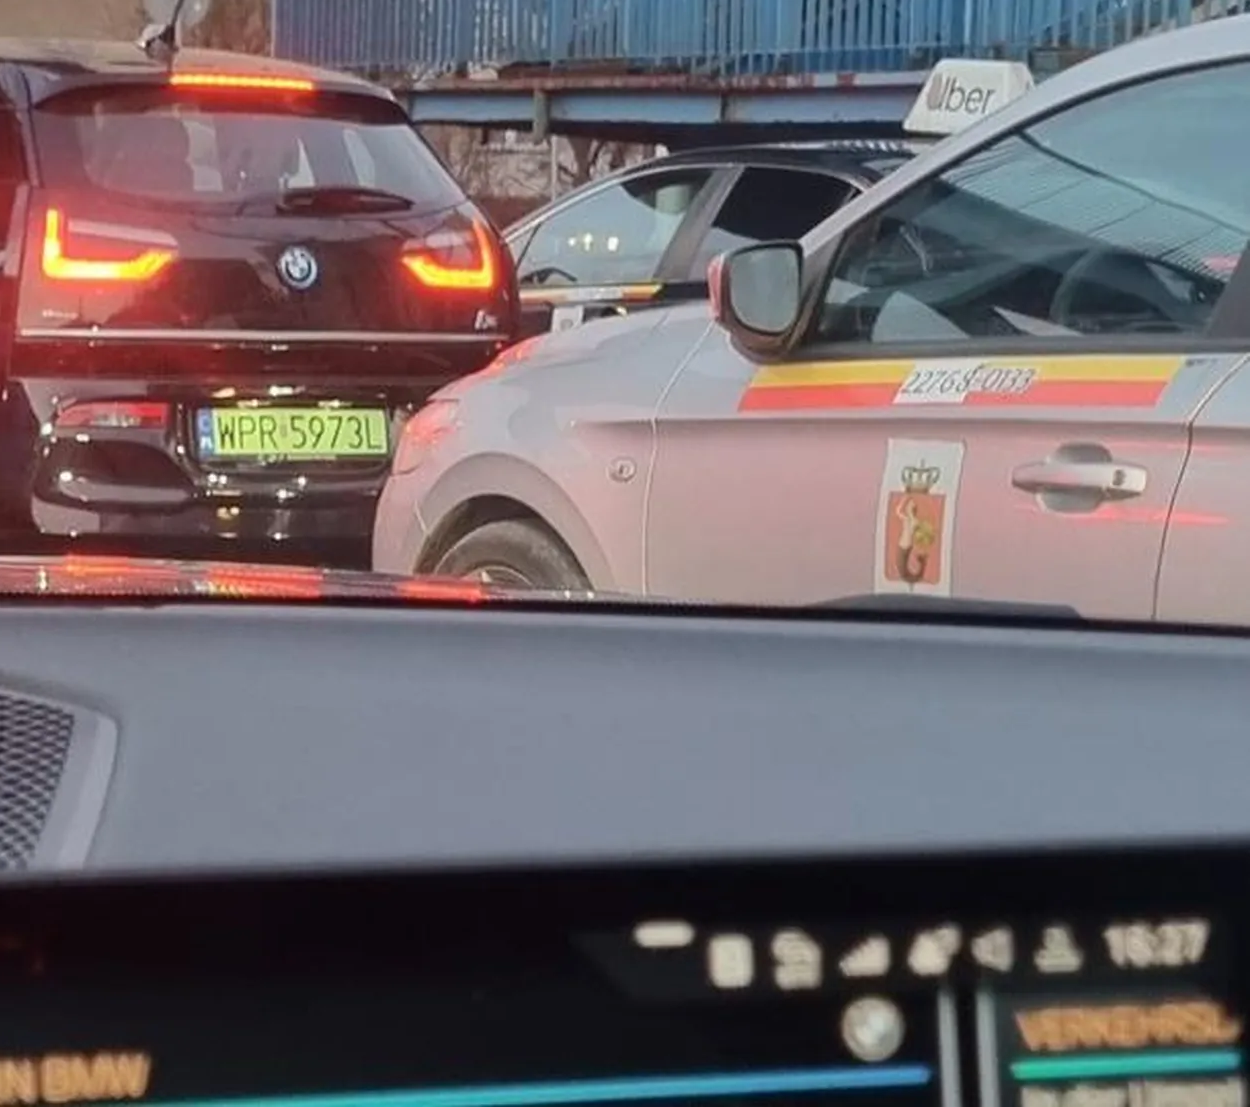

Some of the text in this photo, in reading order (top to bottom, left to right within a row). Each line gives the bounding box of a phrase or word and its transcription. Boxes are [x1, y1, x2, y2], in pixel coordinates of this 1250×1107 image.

[216, 414, 383, 452] WPR 5973L
[40, 1050, 151, 1103] BMW
